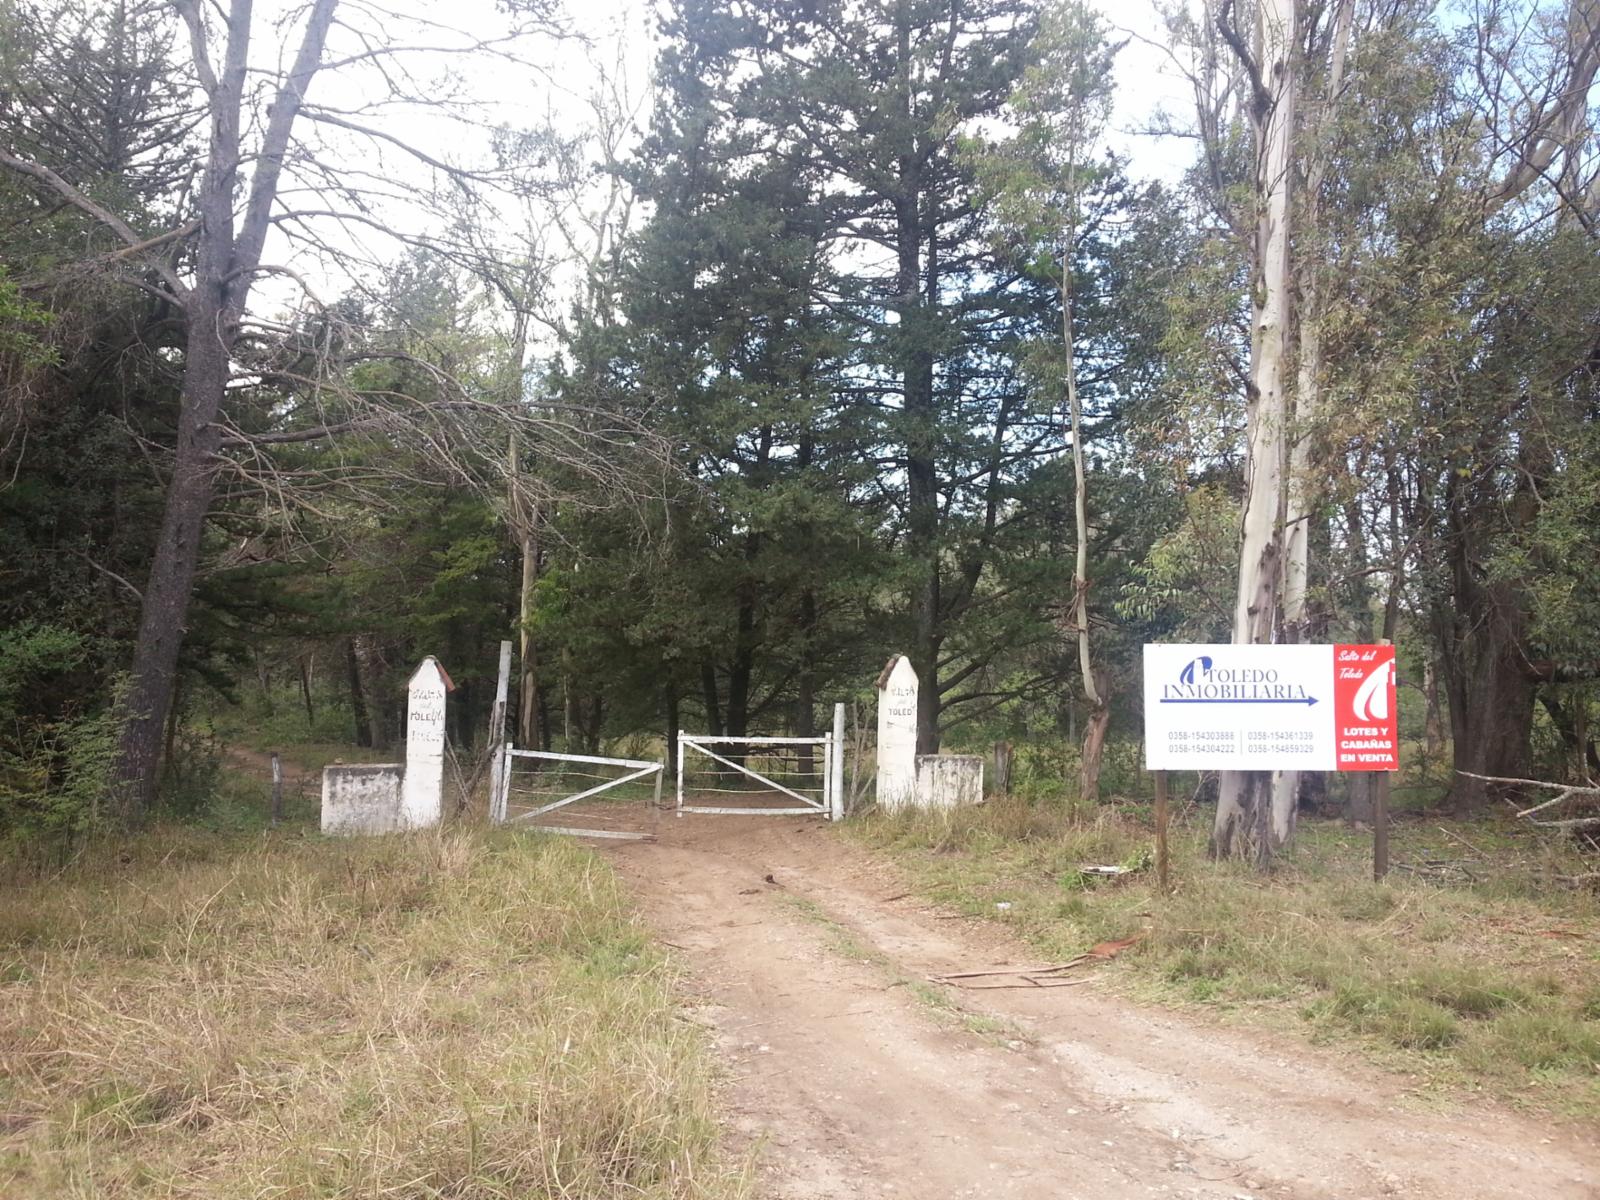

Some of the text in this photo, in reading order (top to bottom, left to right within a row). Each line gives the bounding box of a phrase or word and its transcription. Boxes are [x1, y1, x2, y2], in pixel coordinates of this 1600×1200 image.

[1207, 668, 1278, 683] TOLEDO
[1338, 667, 1364, 680] Toledo
[1163, 684, 1308, 699] INMOBILIARIA
[1343, 727, 1389, 736] LOTES Y
[1340, 739, 1393, 749] CABAÑAS
[1340, 753, 1395, 763] EN VENTA
